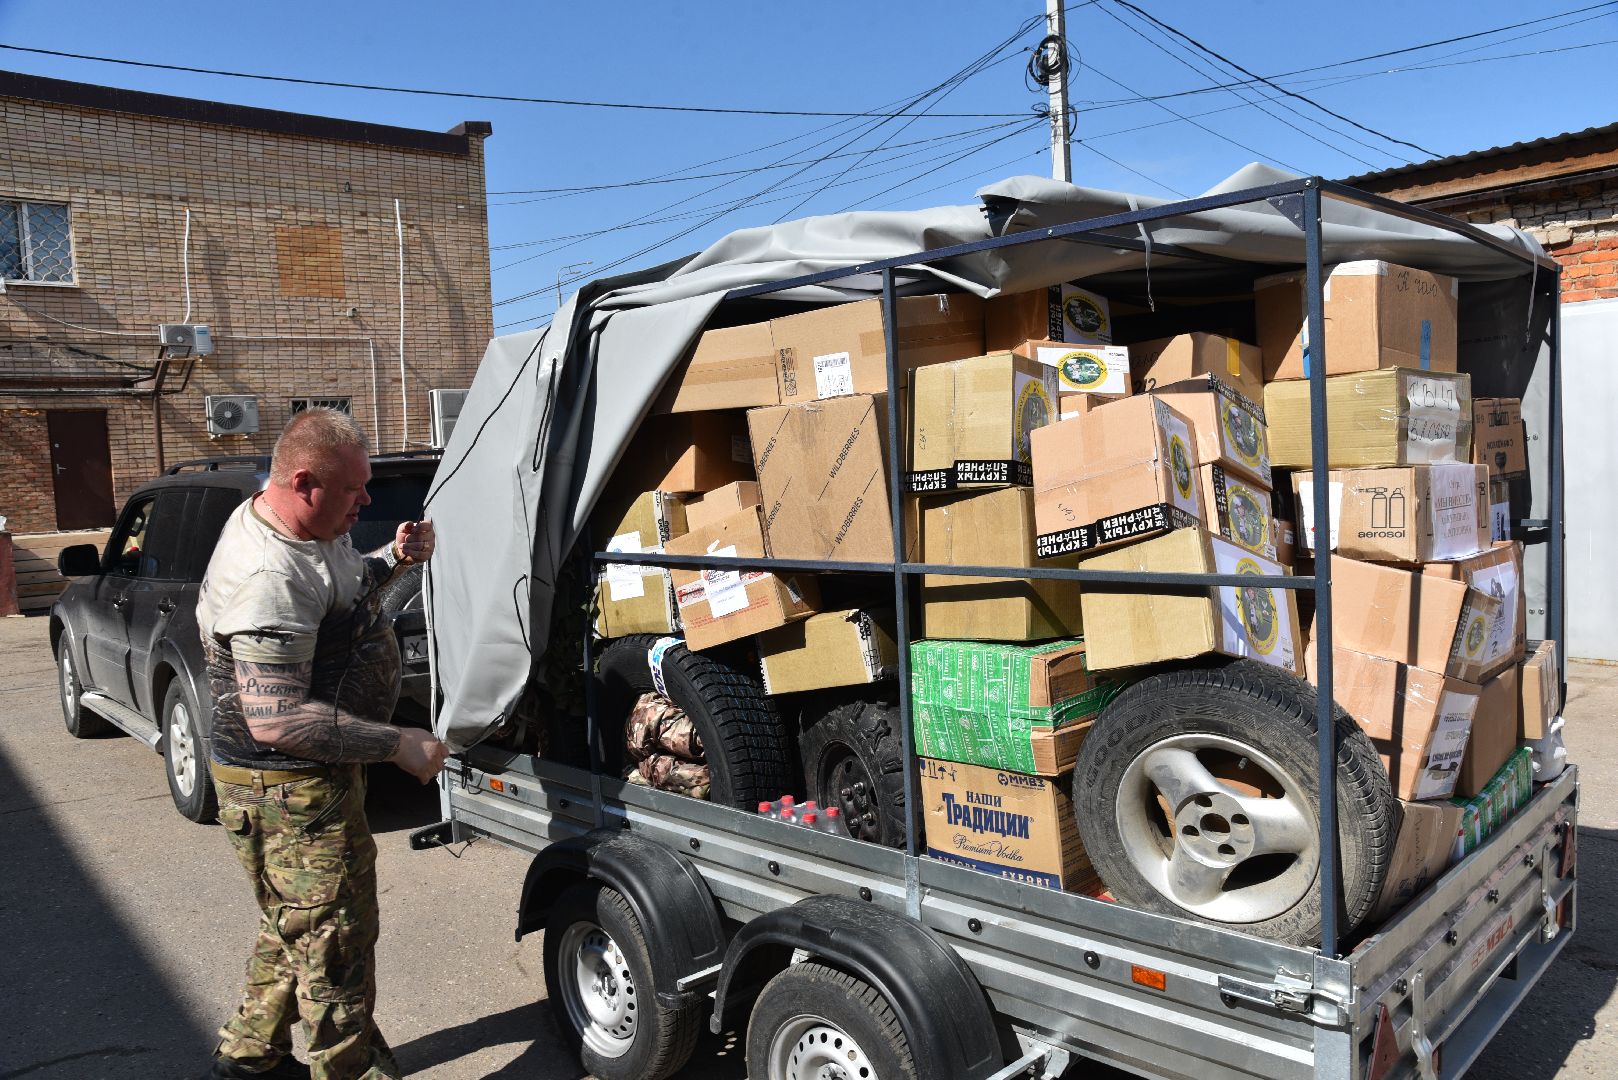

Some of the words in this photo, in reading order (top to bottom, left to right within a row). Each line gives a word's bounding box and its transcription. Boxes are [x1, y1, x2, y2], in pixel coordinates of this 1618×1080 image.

[829, 427, 860, 480] WILDBERRIES
[957, 472, 1000, 481] КРУТЫХ
[834, 496, 864, 545] WILDBERRIES
[1151, 506, 1164, 530] ДЛЯ
[1079, 528, 1088, 547] ДЛЯ
[1103, 518, 1153, 540] КРУТЫХ
[1357, 528, 1406, 539] aerosol
[966, 790, 1002, 808] НАШИ
[952, 832, 993, 855] Premium
[990, 840, 1024, 862] Vodka
[1001, 870, 1050, 887] EXPORT
